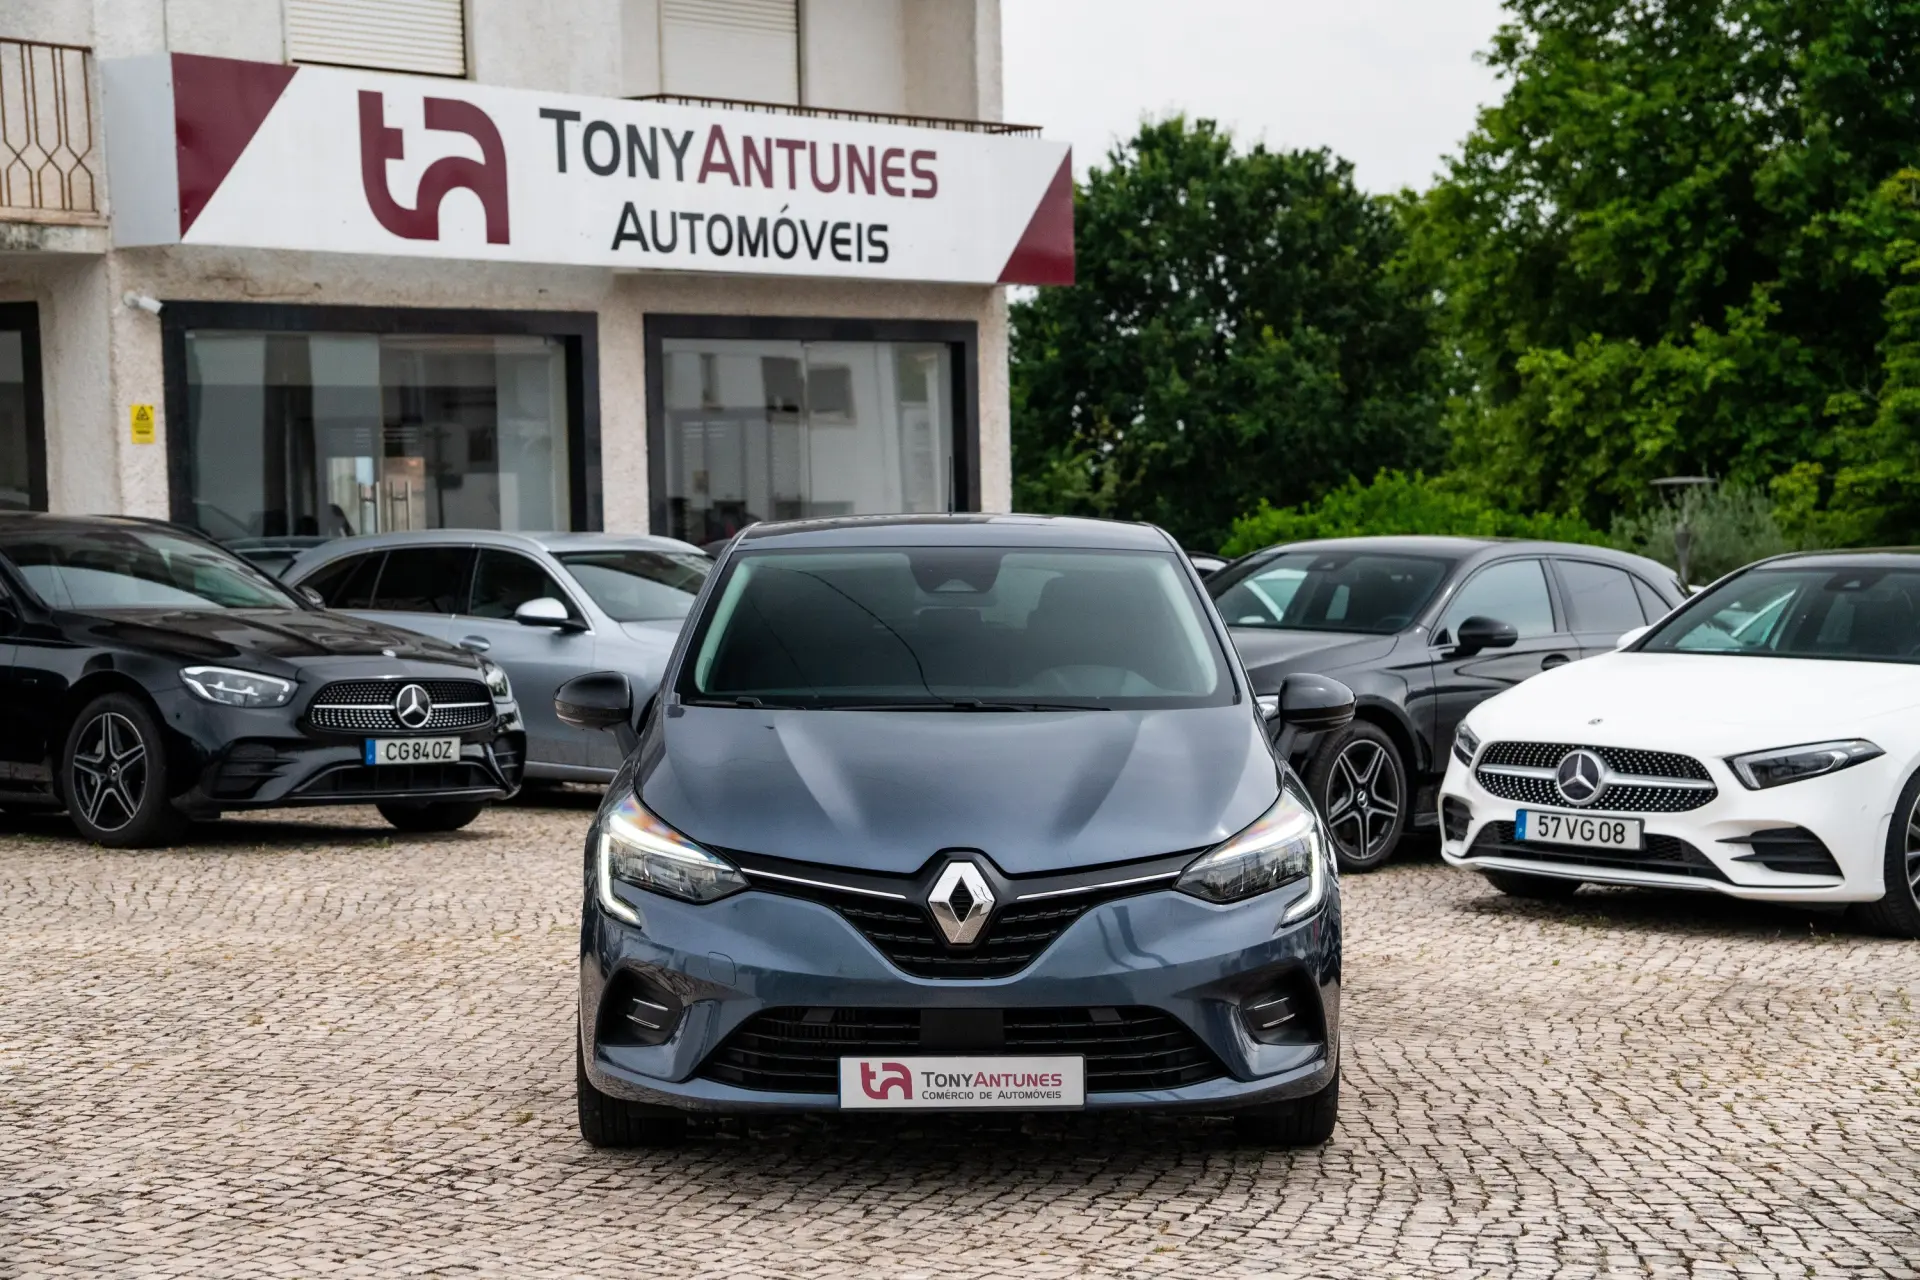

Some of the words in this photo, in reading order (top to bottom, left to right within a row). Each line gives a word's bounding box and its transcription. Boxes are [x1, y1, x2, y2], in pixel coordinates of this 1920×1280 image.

[611, 201, 889, 263] AUTOMÓVEIS
[921, 1089, 974, 1100] COMÉRCIO
[980, 1091, 993, 1100] DE
[997, 1089, 1062, 1100] AUTOMÓVEIS
